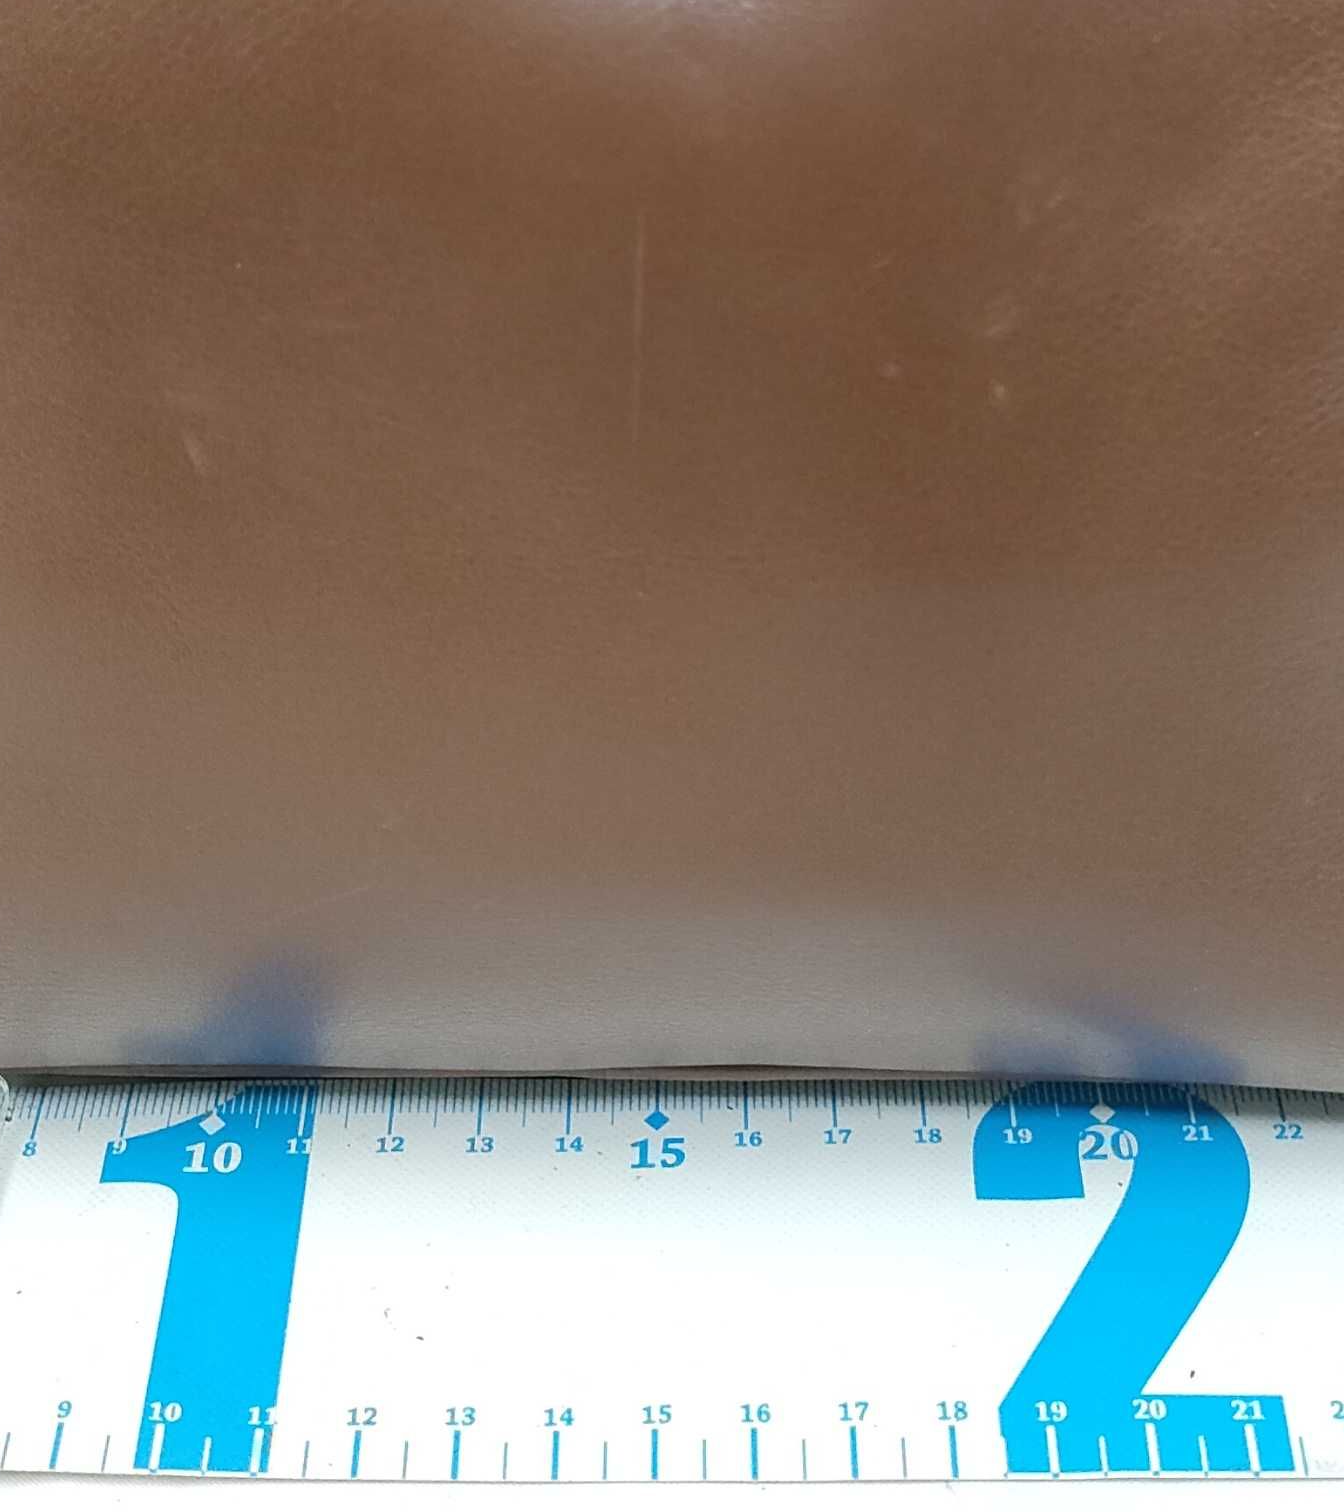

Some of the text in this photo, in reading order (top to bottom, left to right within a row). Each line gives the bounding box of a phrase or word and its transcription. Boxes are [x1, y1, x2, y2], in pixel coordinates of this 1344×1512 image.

[22, 1142, 37, 1156] 8
[110, 1140, 126, 1155] 9
[182, 1141, 242, 1173] 10
[285, 1138, 312, 1154] 11
[376, 1137, 405, 1153] 12
[465, 1137, 494, 1153] 13
[555, 1137, 583, 1153] 14
[630, 1138, 686, 1168] 15
[734, 1131, 763, 1147] 16
[823, 1129, 852, 1144] 17
[914, 1128, 943, 1144] 18
[1003, 1128, 1033, 1144] 19
[1080, 1129, 1138, 1160] 20
[1182, 1126, 1213, 1141] 21
[1273, 1124, 1303, 1139] 22
[100, 1085, 316, 1473] 1
[973, 1082, 1291, 1472] 2
[56, 1401, 71, 1418] 9
[149, 1402, 182, 1421] 10
[247, 1407, 277, 1425] 11
[346, 1407, 377, 1426] 12
[445, 1407, 476, 1426] 13
[544, 1408, 574, 1426] 14
[641, 1405, 672, 1424] 15
[740, 1404, 771, 1423] 16
[838, 1402, 869, 1421] 17
[937, 1402, 968, 1421] 18
[1034, 1402, 1067, 1421] 19
[1132, 1400, 1167, 1419] 20
[1231, 1400, 1264, 1419] 21
